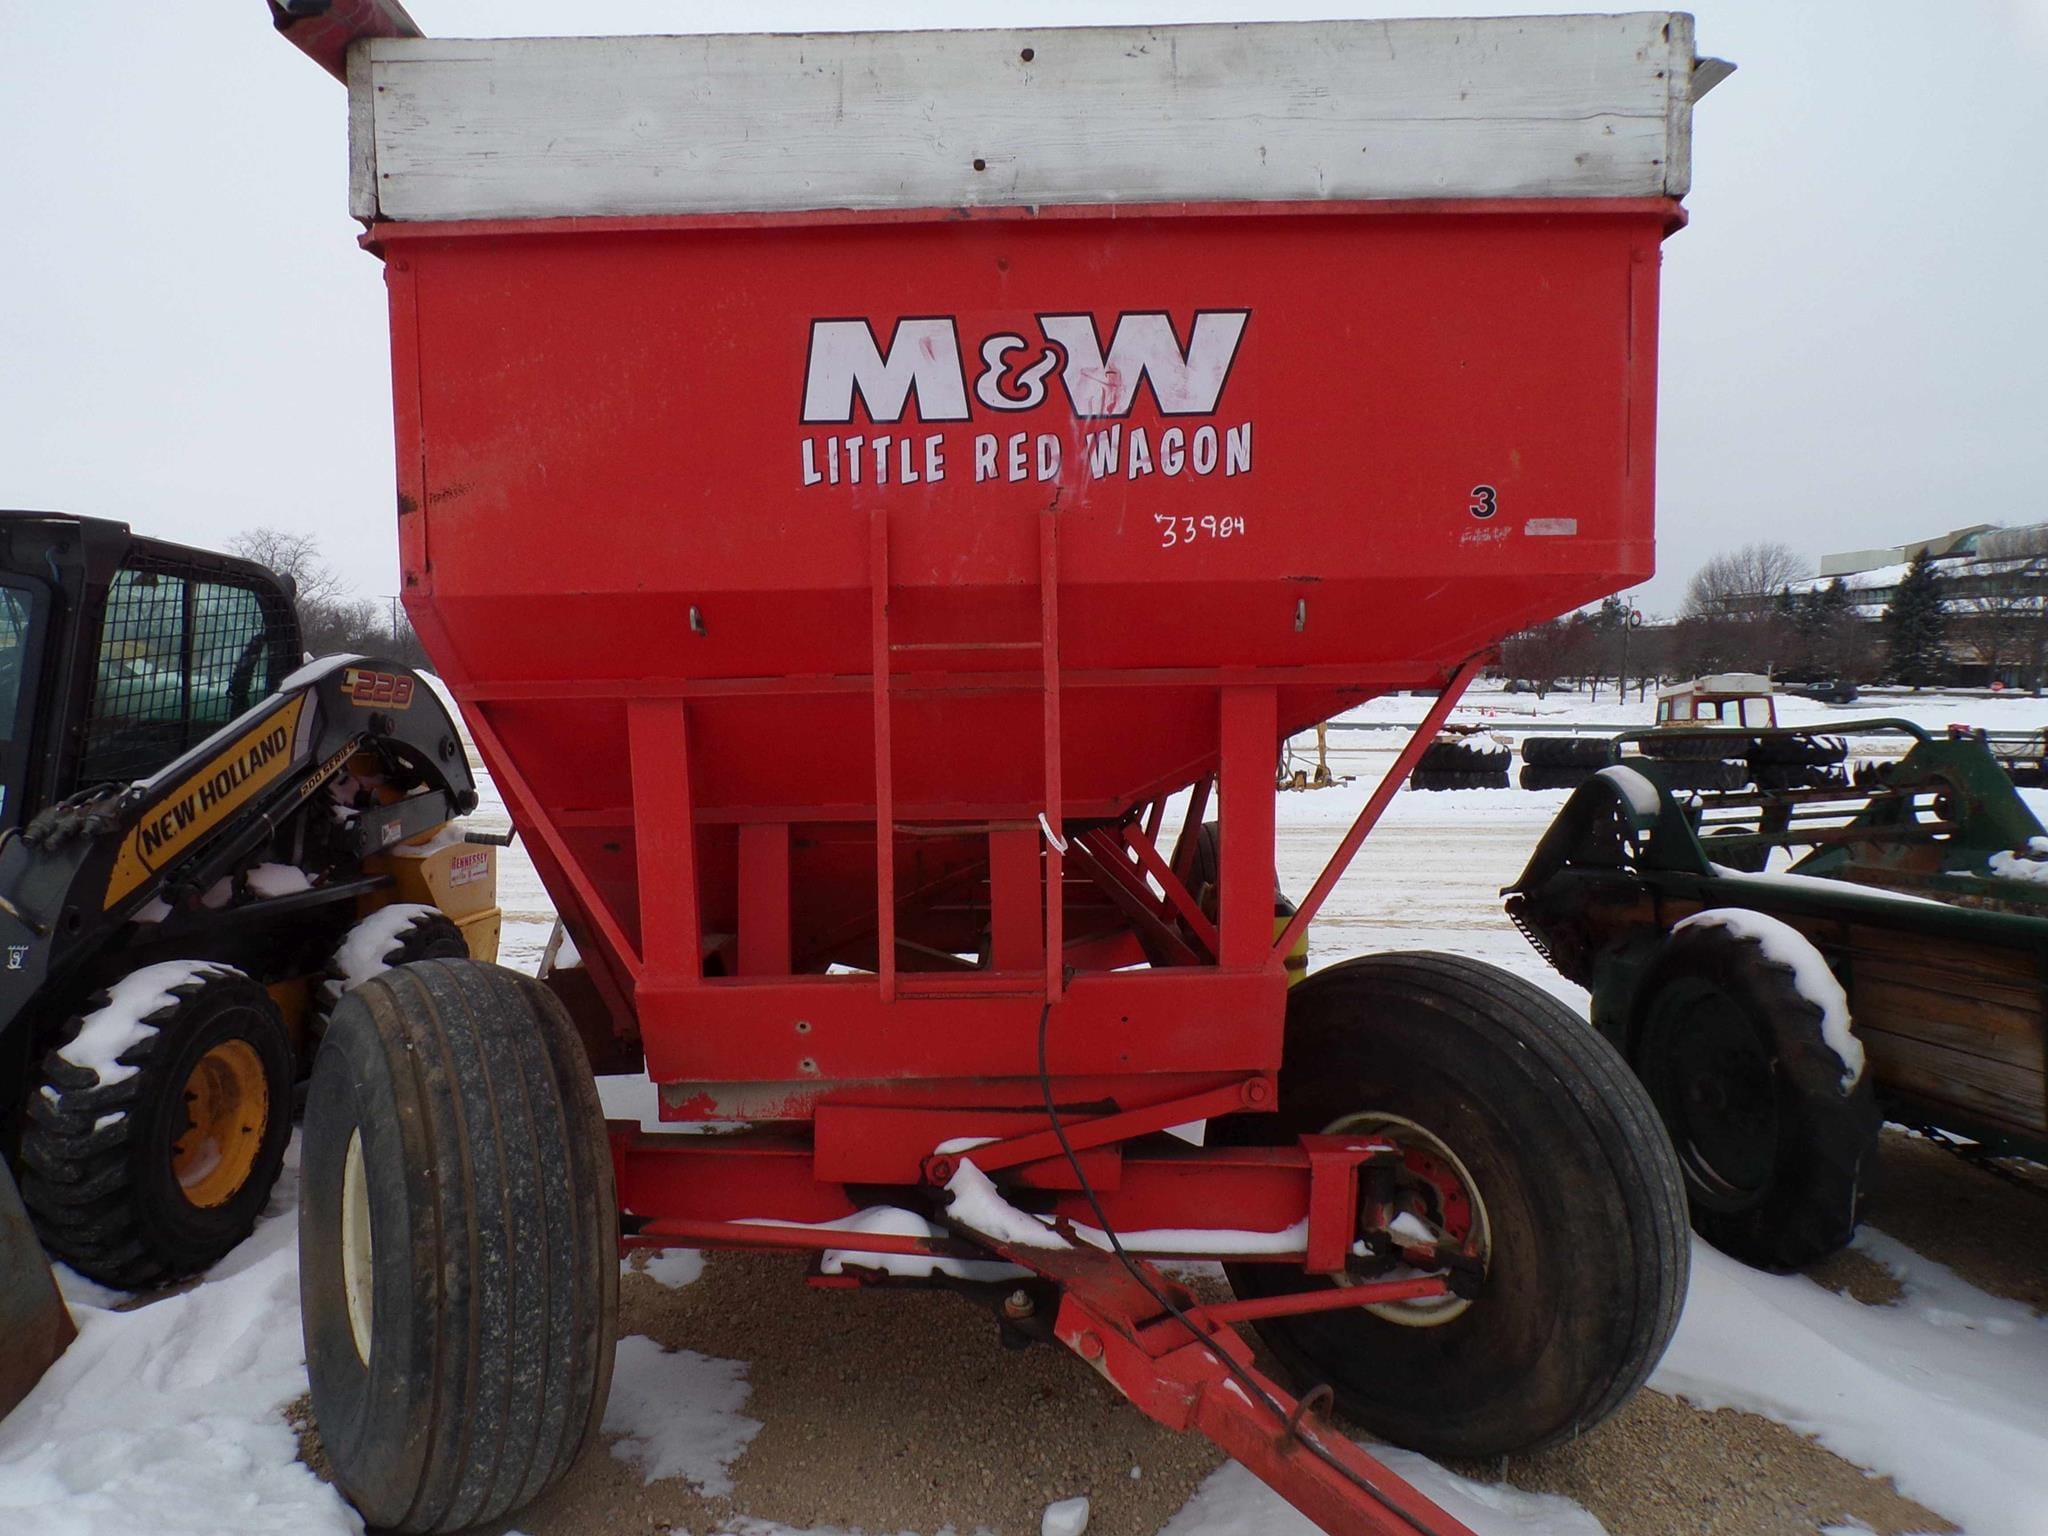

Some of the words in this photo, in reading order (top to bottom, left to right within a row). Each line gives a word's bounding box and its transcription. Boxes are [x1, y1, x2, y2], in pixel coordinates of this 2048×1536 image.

[800, 308, 1252, 424] M&W
[801, 433, 945, 487] LITTLE
[975, 432, 1062, 483] RED
[1086, 422, 1253, 482] WAGON
[1469, 484, 1497, 519] 3
[141, 794, 195, 856] NEW
[198, 726, 288, 812] HOLLAND
[301, 771, 322, 797] 200
[322, 741, 356, 775] SERIES
